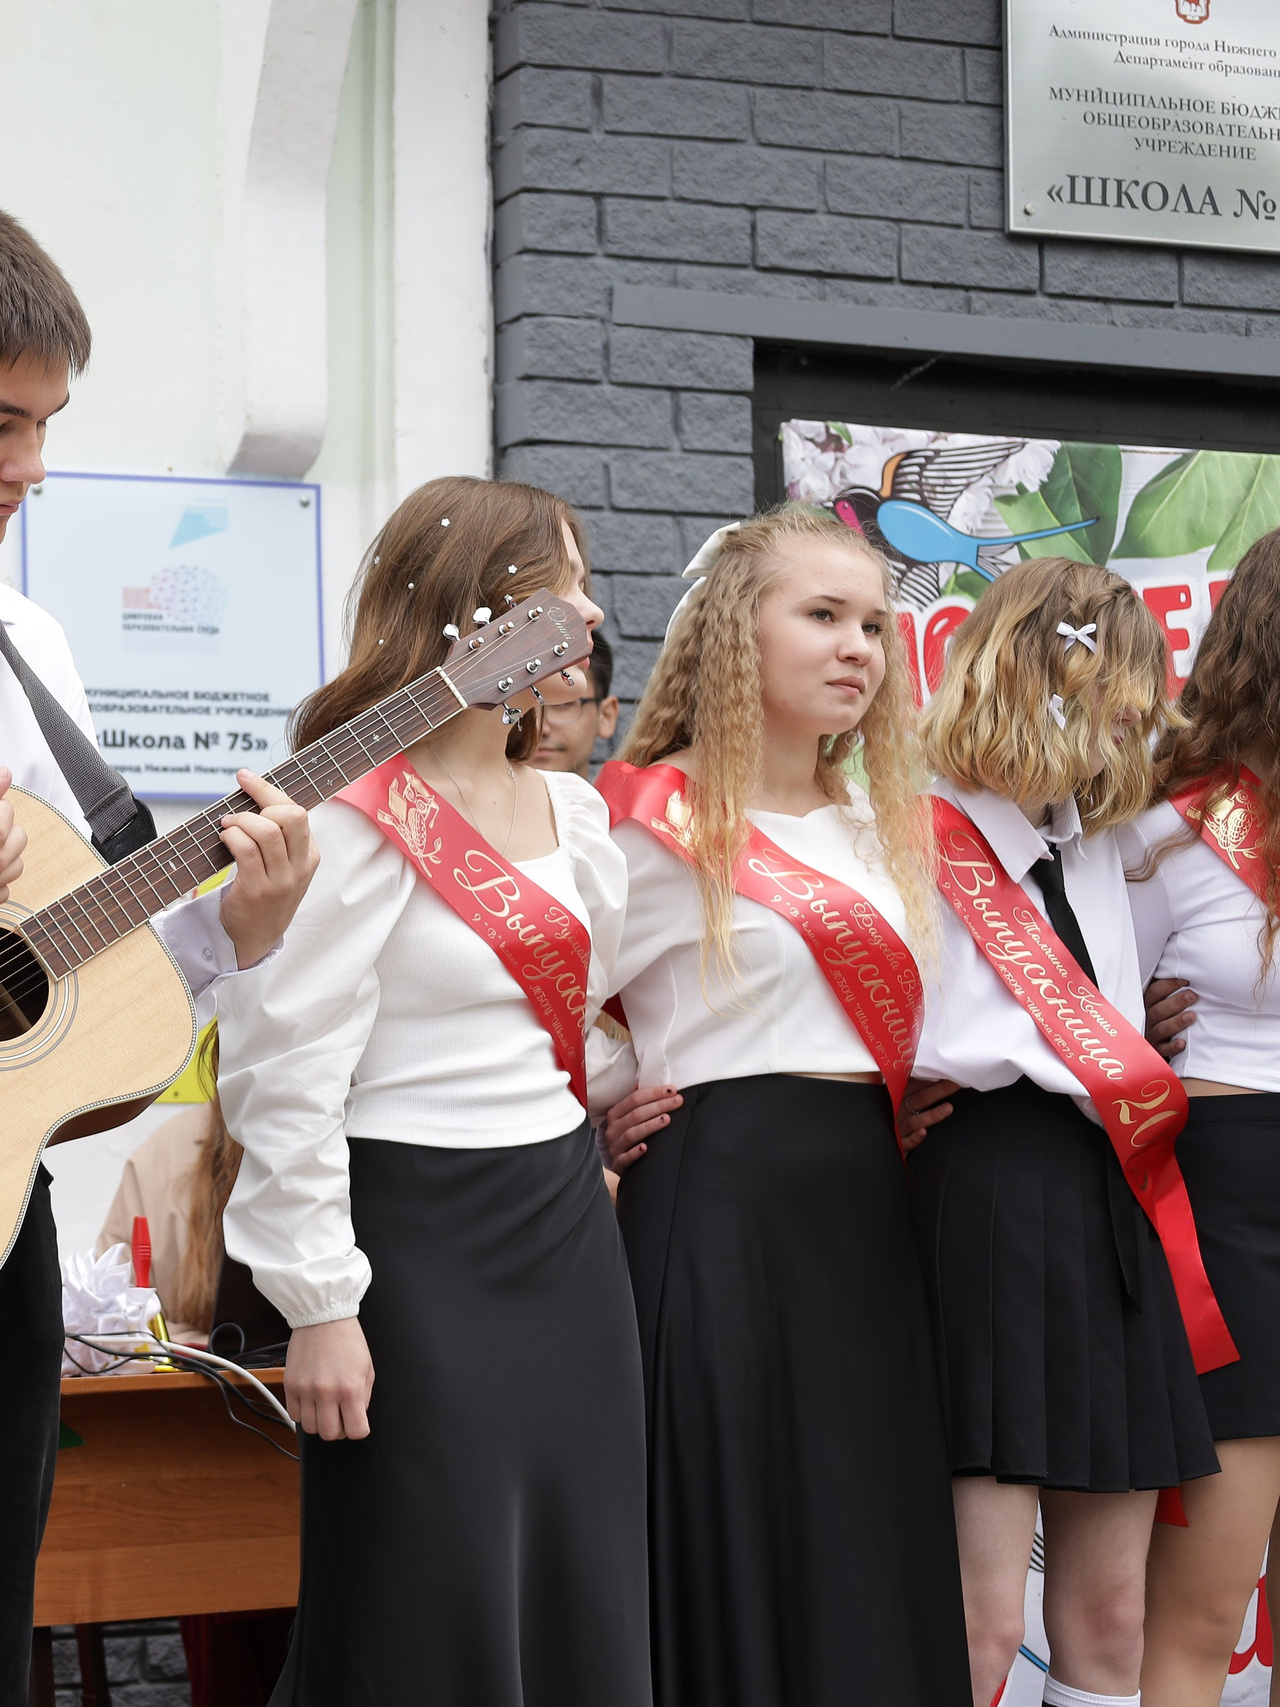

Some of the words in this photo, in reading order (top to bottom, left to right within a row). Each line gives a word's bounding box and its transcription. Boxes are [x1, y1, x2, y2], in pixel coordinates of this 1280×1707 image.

[1049, 24, 1160, 46] Администрация
[1165, 37, 1210, 51] города
[1214, 40, 1277, 58] Нижнего
[1113, 50, 1205, 71] Департамент
[1083, 111, 1280, 142] ОБЩЕОБРАЗОВАТЕЛЬН
[1220, 101, 1280, 120] БЮДЖ
[1134, 137, 1256, 161] УЧРЕЖДЕНИЕ
[1046, 174, 1223, 216] «ШКОЛА
[1233, 188, 1278, 221] №
[88, 704, 211, 716] ЕОБРАЗОВАТЕЛЬНОЕ
[193, 690, 270, 702] БЮДЖЕТНОЕ
[193, 731, 221, 751] №
[227, 732, 268, 752] 75»
[850, 901, 906, 971] Фадеева
[747, 848, 914, 1079] Выпускница
[937, 830, 1125, 1080] Выпускница
[993, 960, 1026, 997] МБОУ
[1067, 980, 1119, 1037] Ксения
